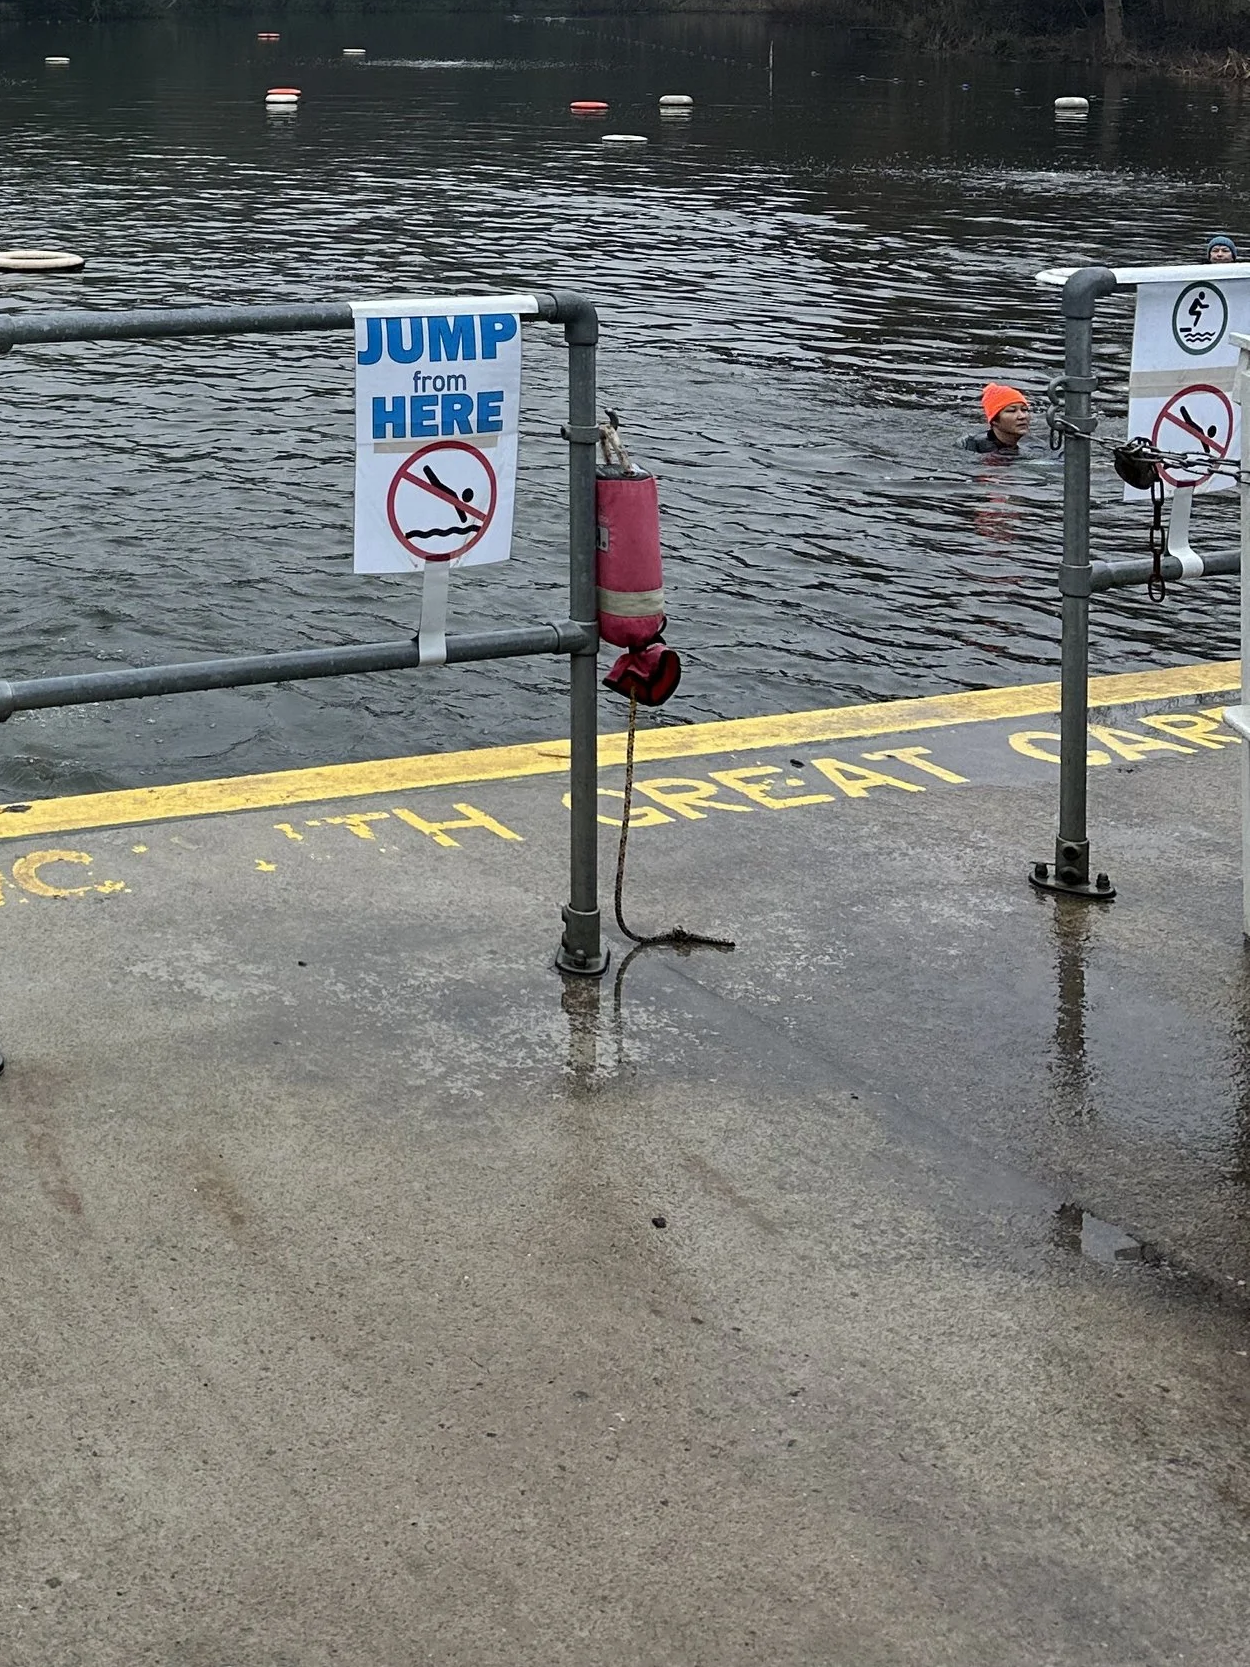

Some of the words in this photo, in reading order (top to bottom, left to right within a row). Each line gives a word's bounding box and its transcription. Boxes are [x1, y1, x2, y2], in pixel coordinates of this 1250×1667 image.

[357, 313, 518, 365] JUMP
[412, 370, 467, 393] from
[372, 390, 505, 439] HERE
[561, 745, 971, 828] GREAT
[1008, 705, 1243, 767] CAR
